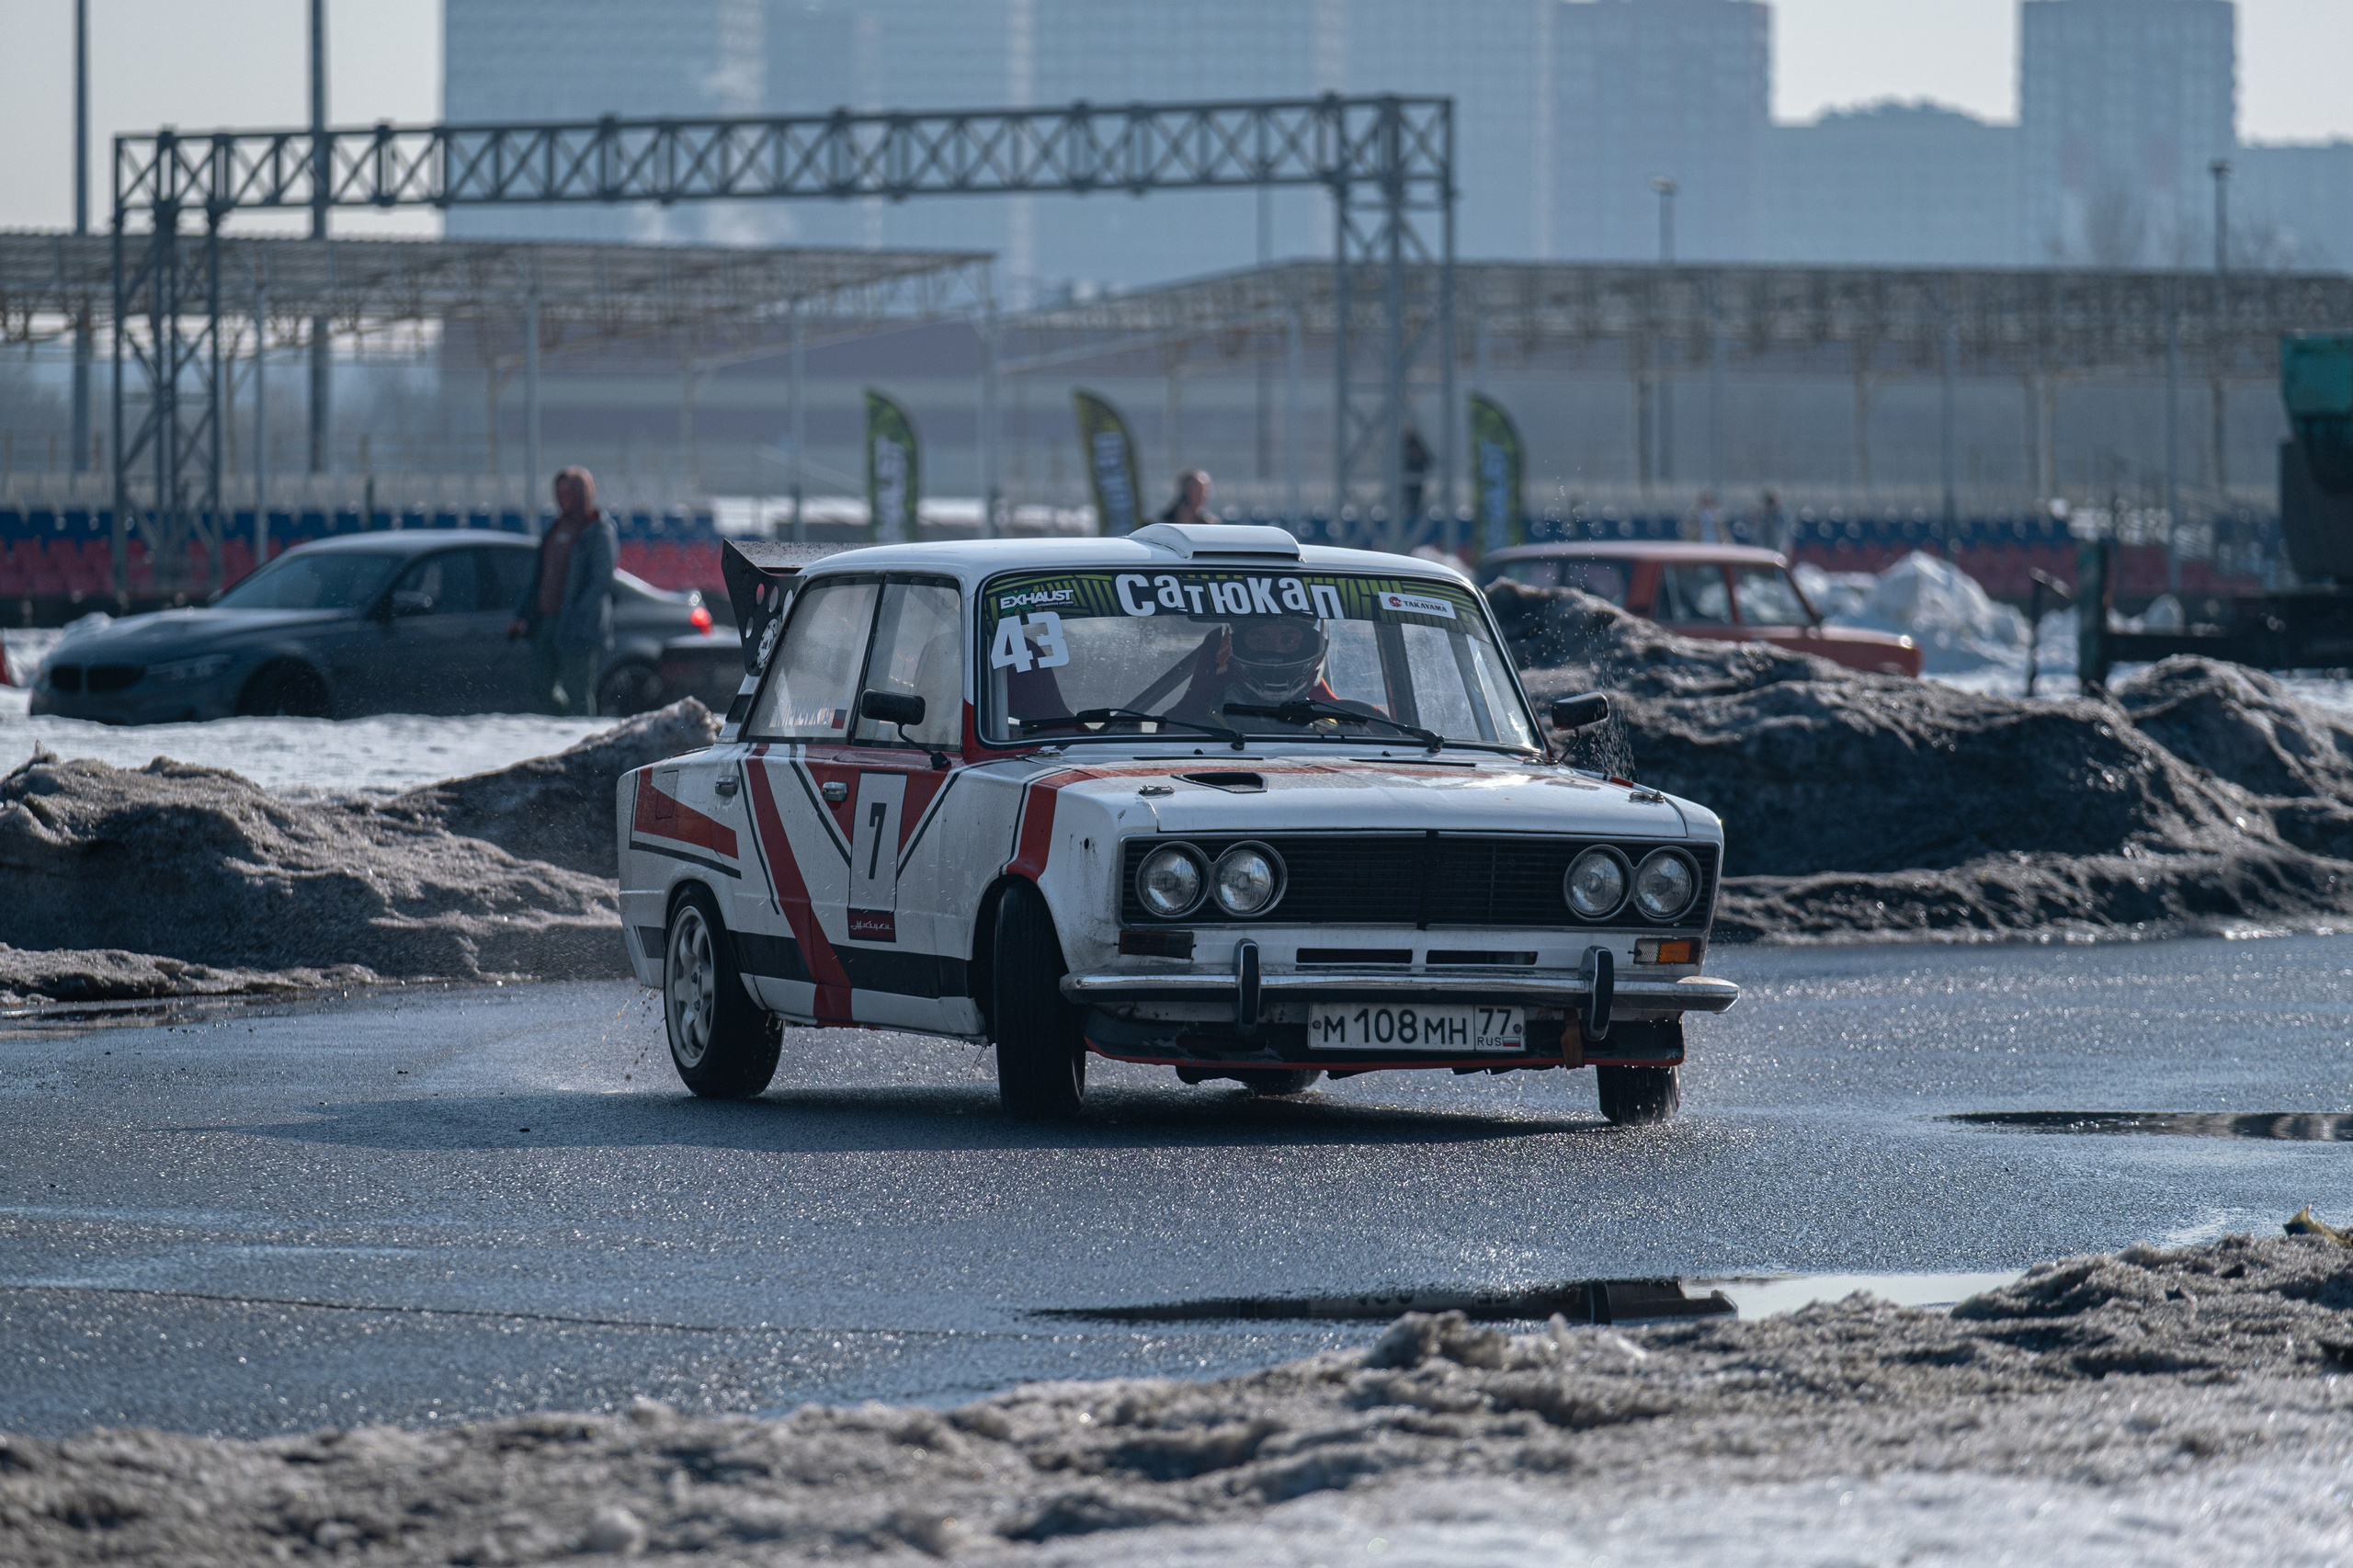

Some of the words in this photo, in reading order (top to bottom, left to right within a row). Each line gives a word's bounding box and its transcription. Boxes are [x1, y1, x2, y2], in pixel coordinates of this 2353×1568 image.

[1000, 589, 1074, 610] EXHAUST
[1403, 600, 1448, 613] TAKAYAMA
[990, 610, 1070, 673] 43
[869, 802, 888, 880] 7
[1478, 1007, 1512, 1036] 77
[1477, 1037, 1502, 1047] RUS
